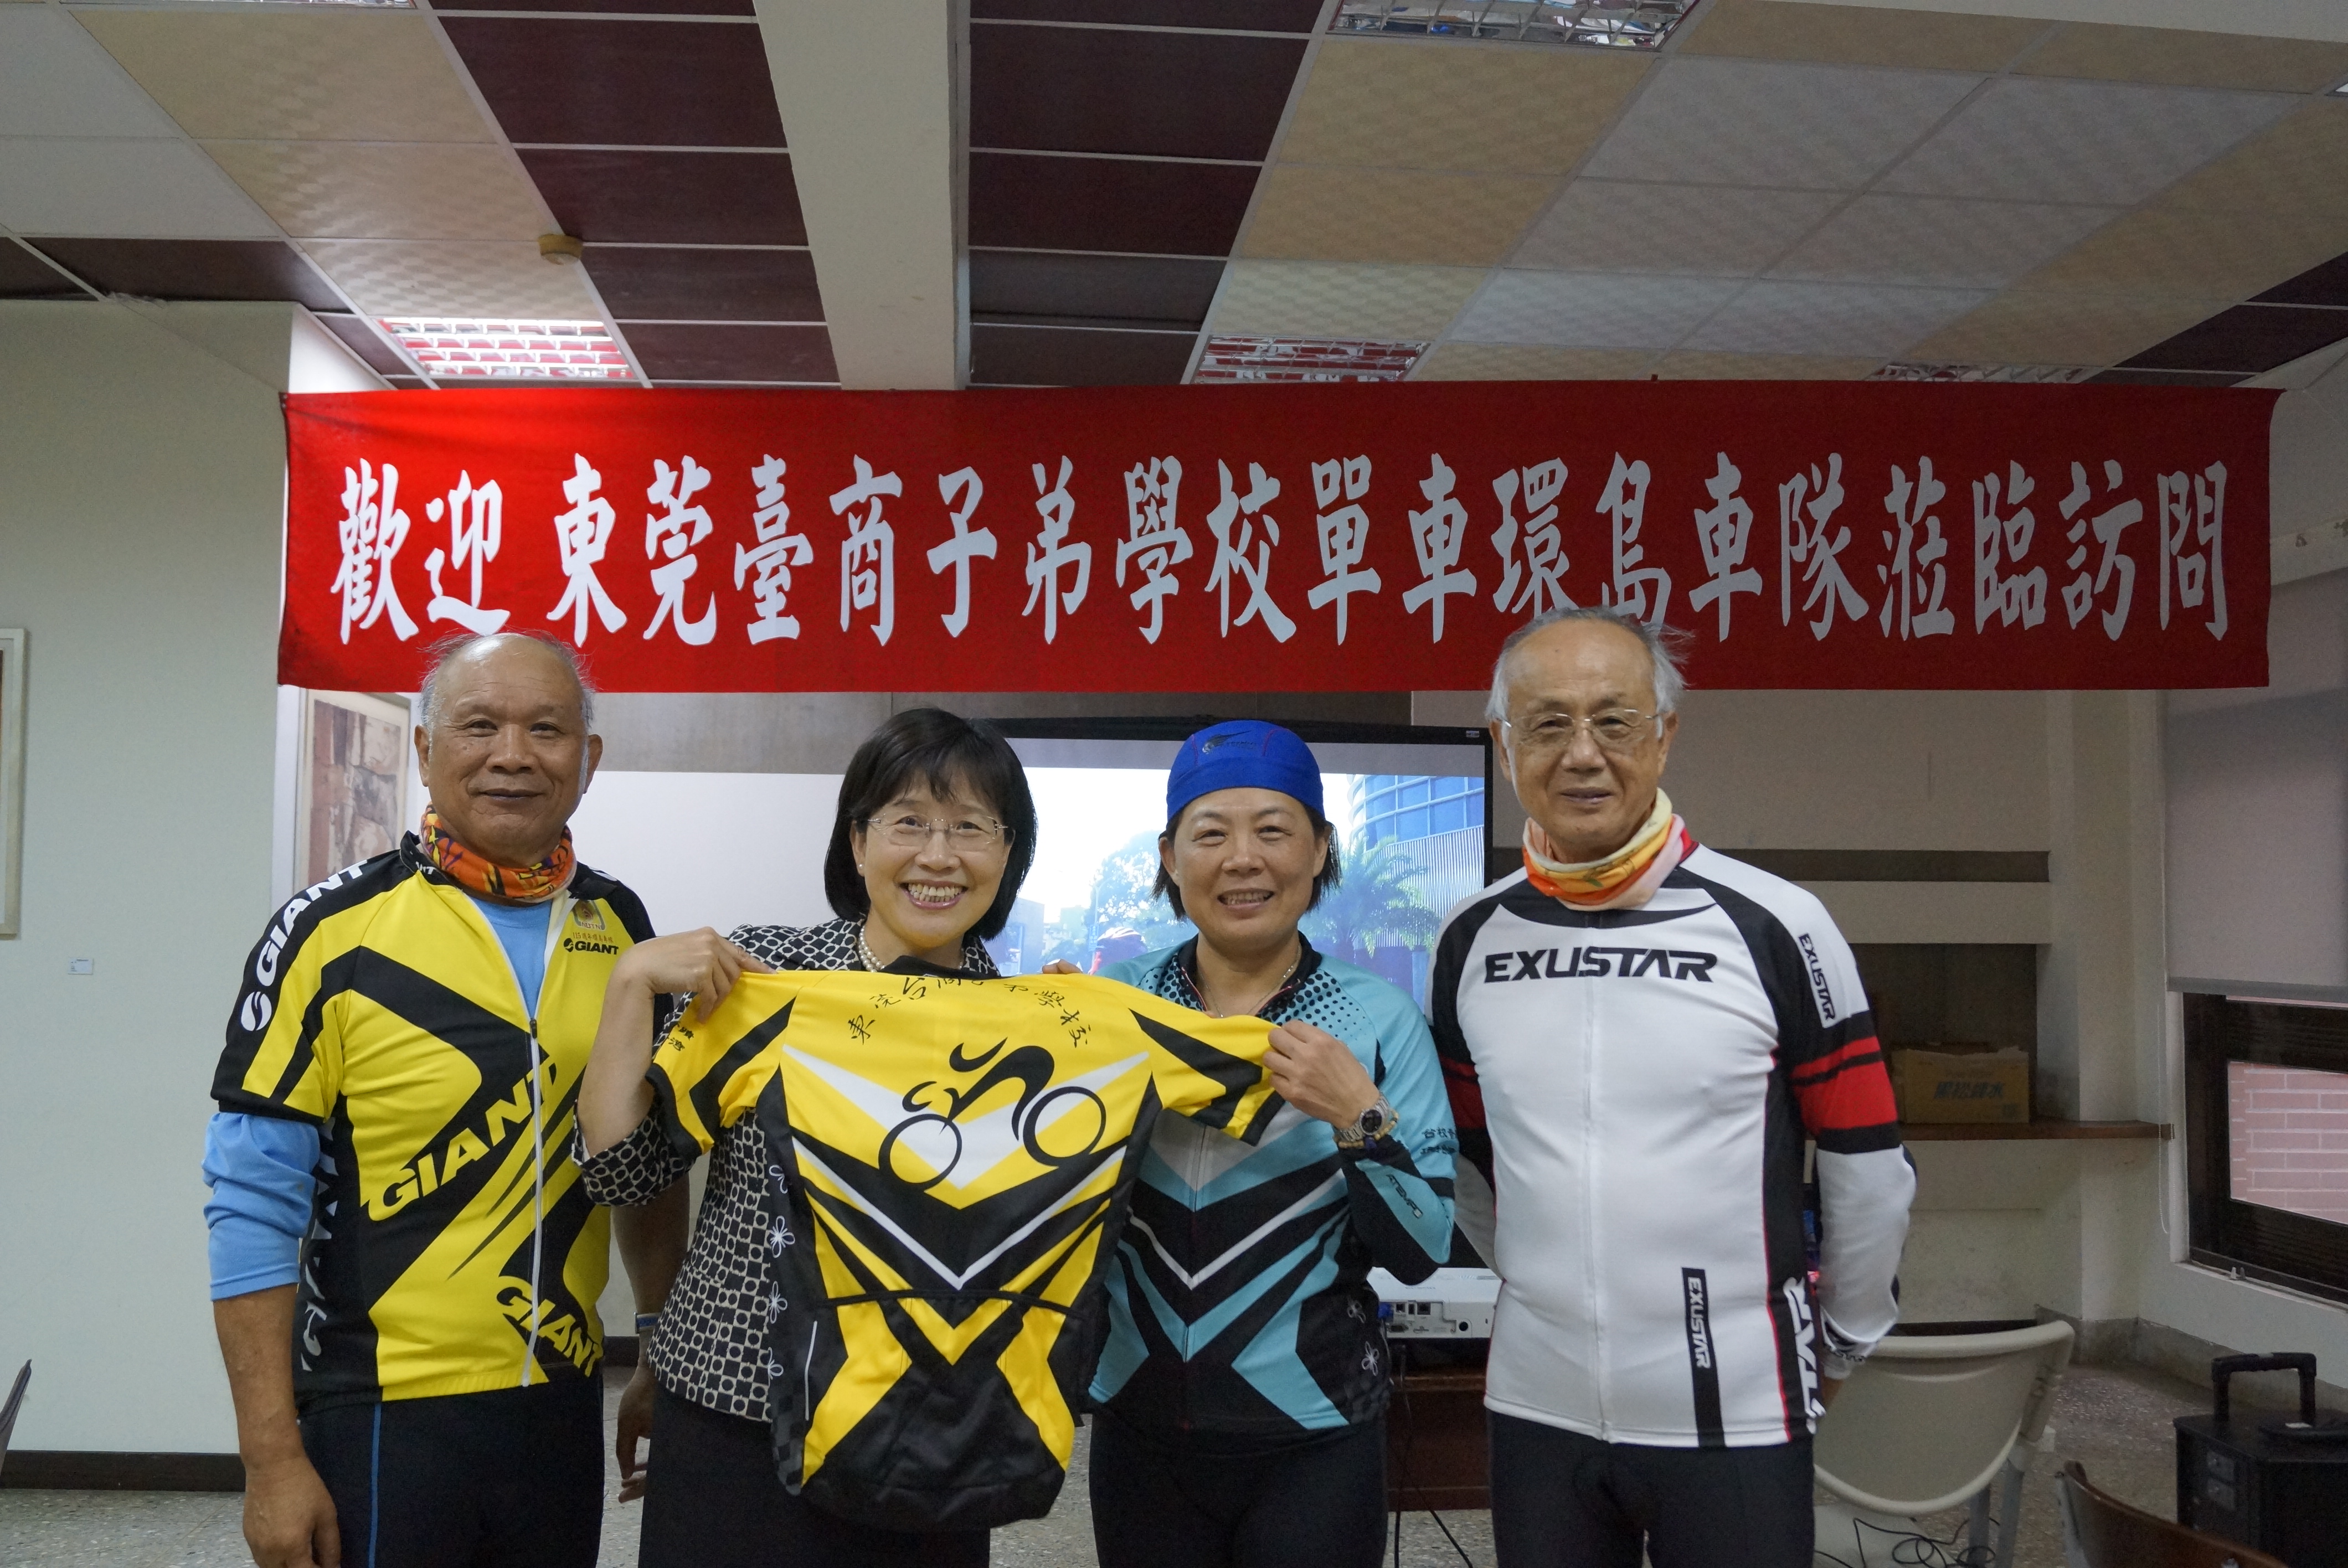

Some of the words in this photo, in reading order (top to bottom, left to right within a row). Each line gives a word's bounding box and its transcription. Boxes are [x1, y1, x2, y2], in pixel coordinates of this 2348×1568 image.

[331, 457, 510, 646] 歡迎
[257, 859, 368, 987] GIANT
[574, 941, 619, 955] GIANT
[1484, 946, 1718, 983] EXUSTAR
[1799, 933, 1835, 1021] EXUSTAR
[493, 1276, 604, 1378] GIANT
[1687, 1277, 1712, 1370] EXUSTAR
